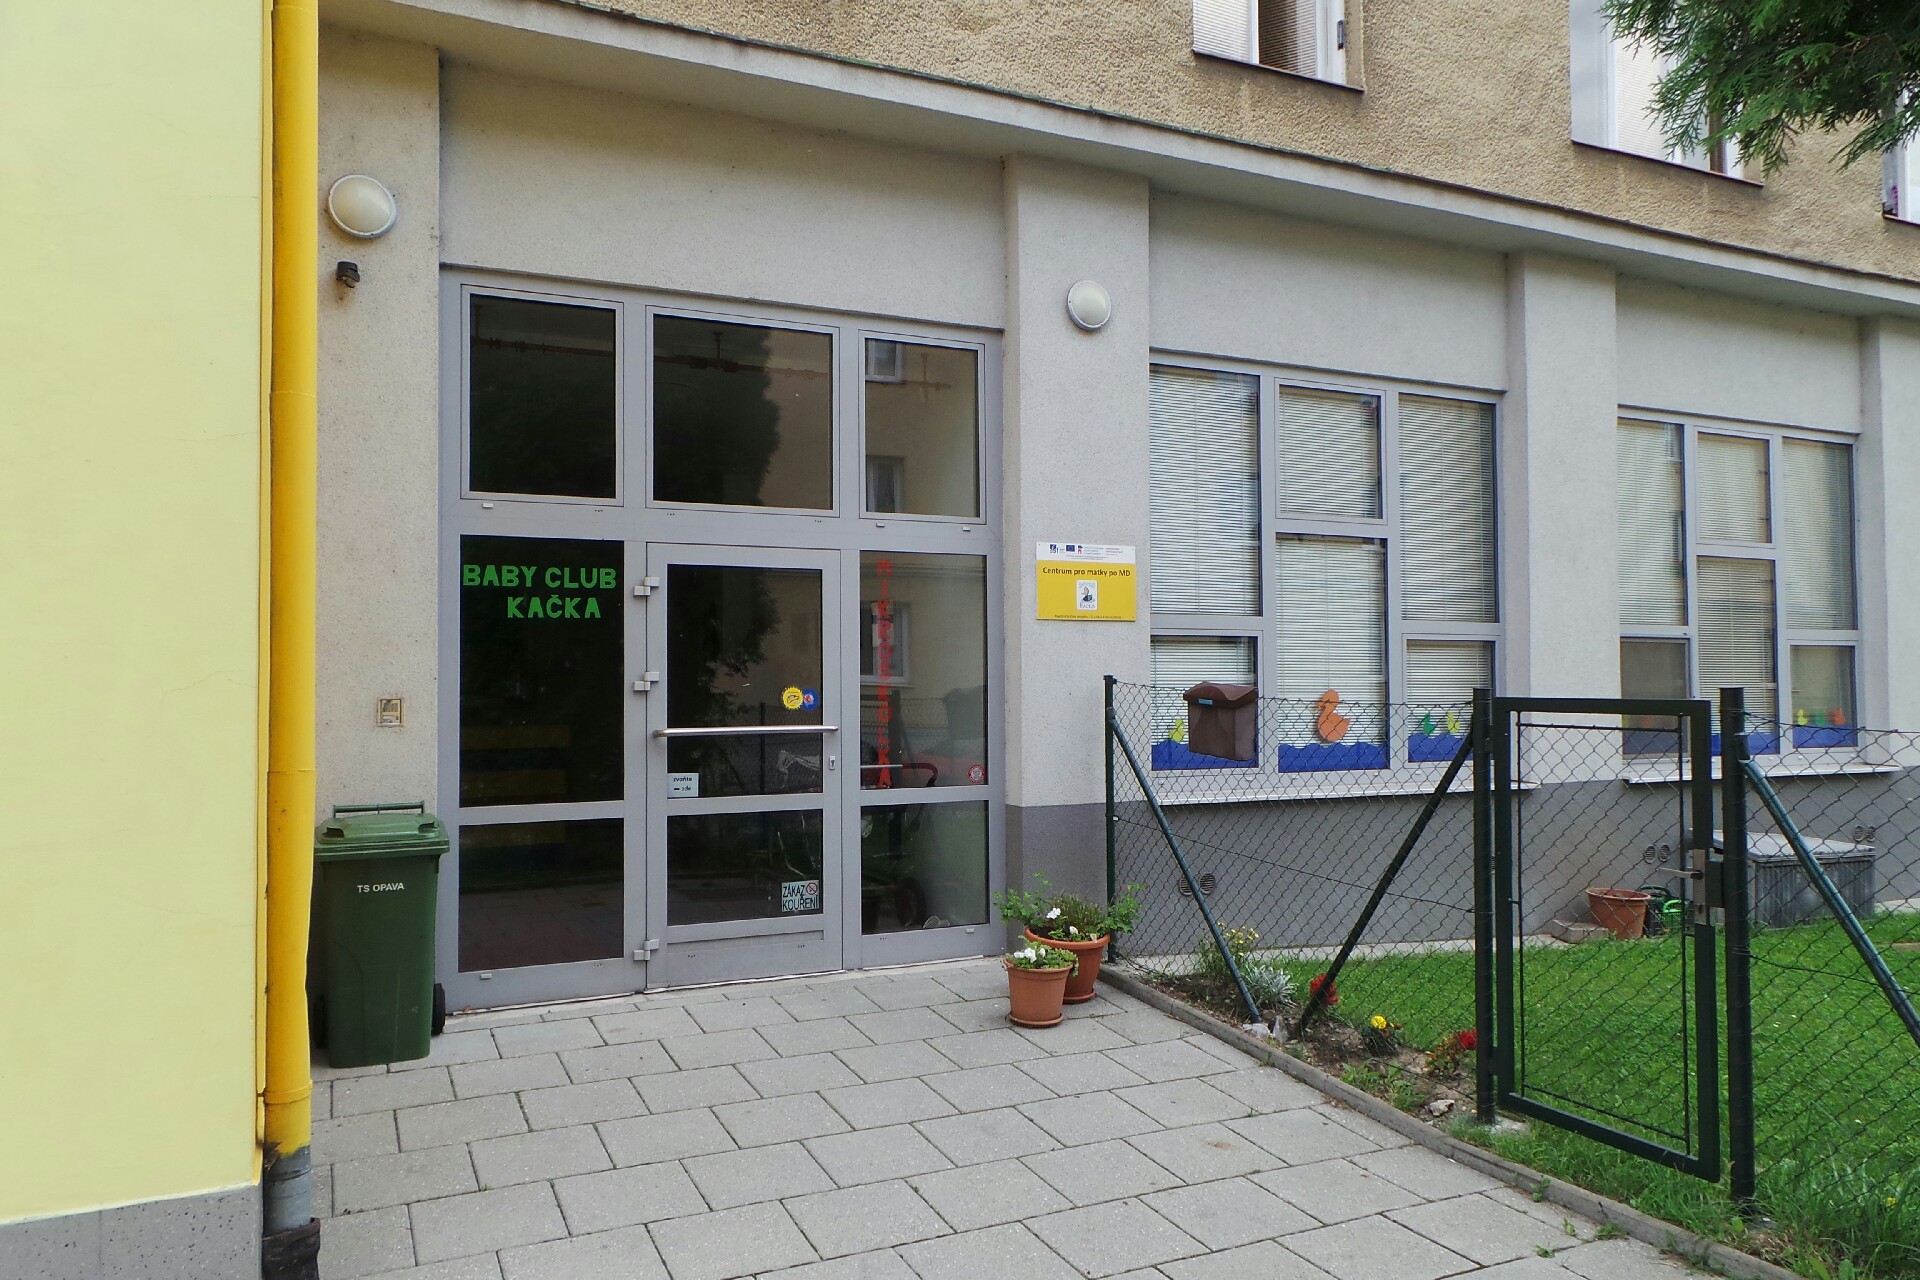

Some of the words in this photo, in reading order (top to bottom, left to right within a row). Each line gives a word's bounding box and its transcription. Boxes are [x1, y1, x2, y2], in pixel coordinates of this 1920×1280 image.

[462, 564, 537, 588] BABY
[545, 567, 617, 589] CLUB
[1042, 566, 1072, 575] Centrum
[1073, 568, 1086, 576] pro
[1087, 567, 1108, 577] matky
[1119, 569, 1131, 577] MD
[507, 594, 602, 619] KAČKA
[357, 884, 370, 893] TS
[372, 882, 405, 892] OPAVA
[782, 883, 805, 898] ZÁKAZ
[782, 894, 818, 911] KOUŘENÍ
